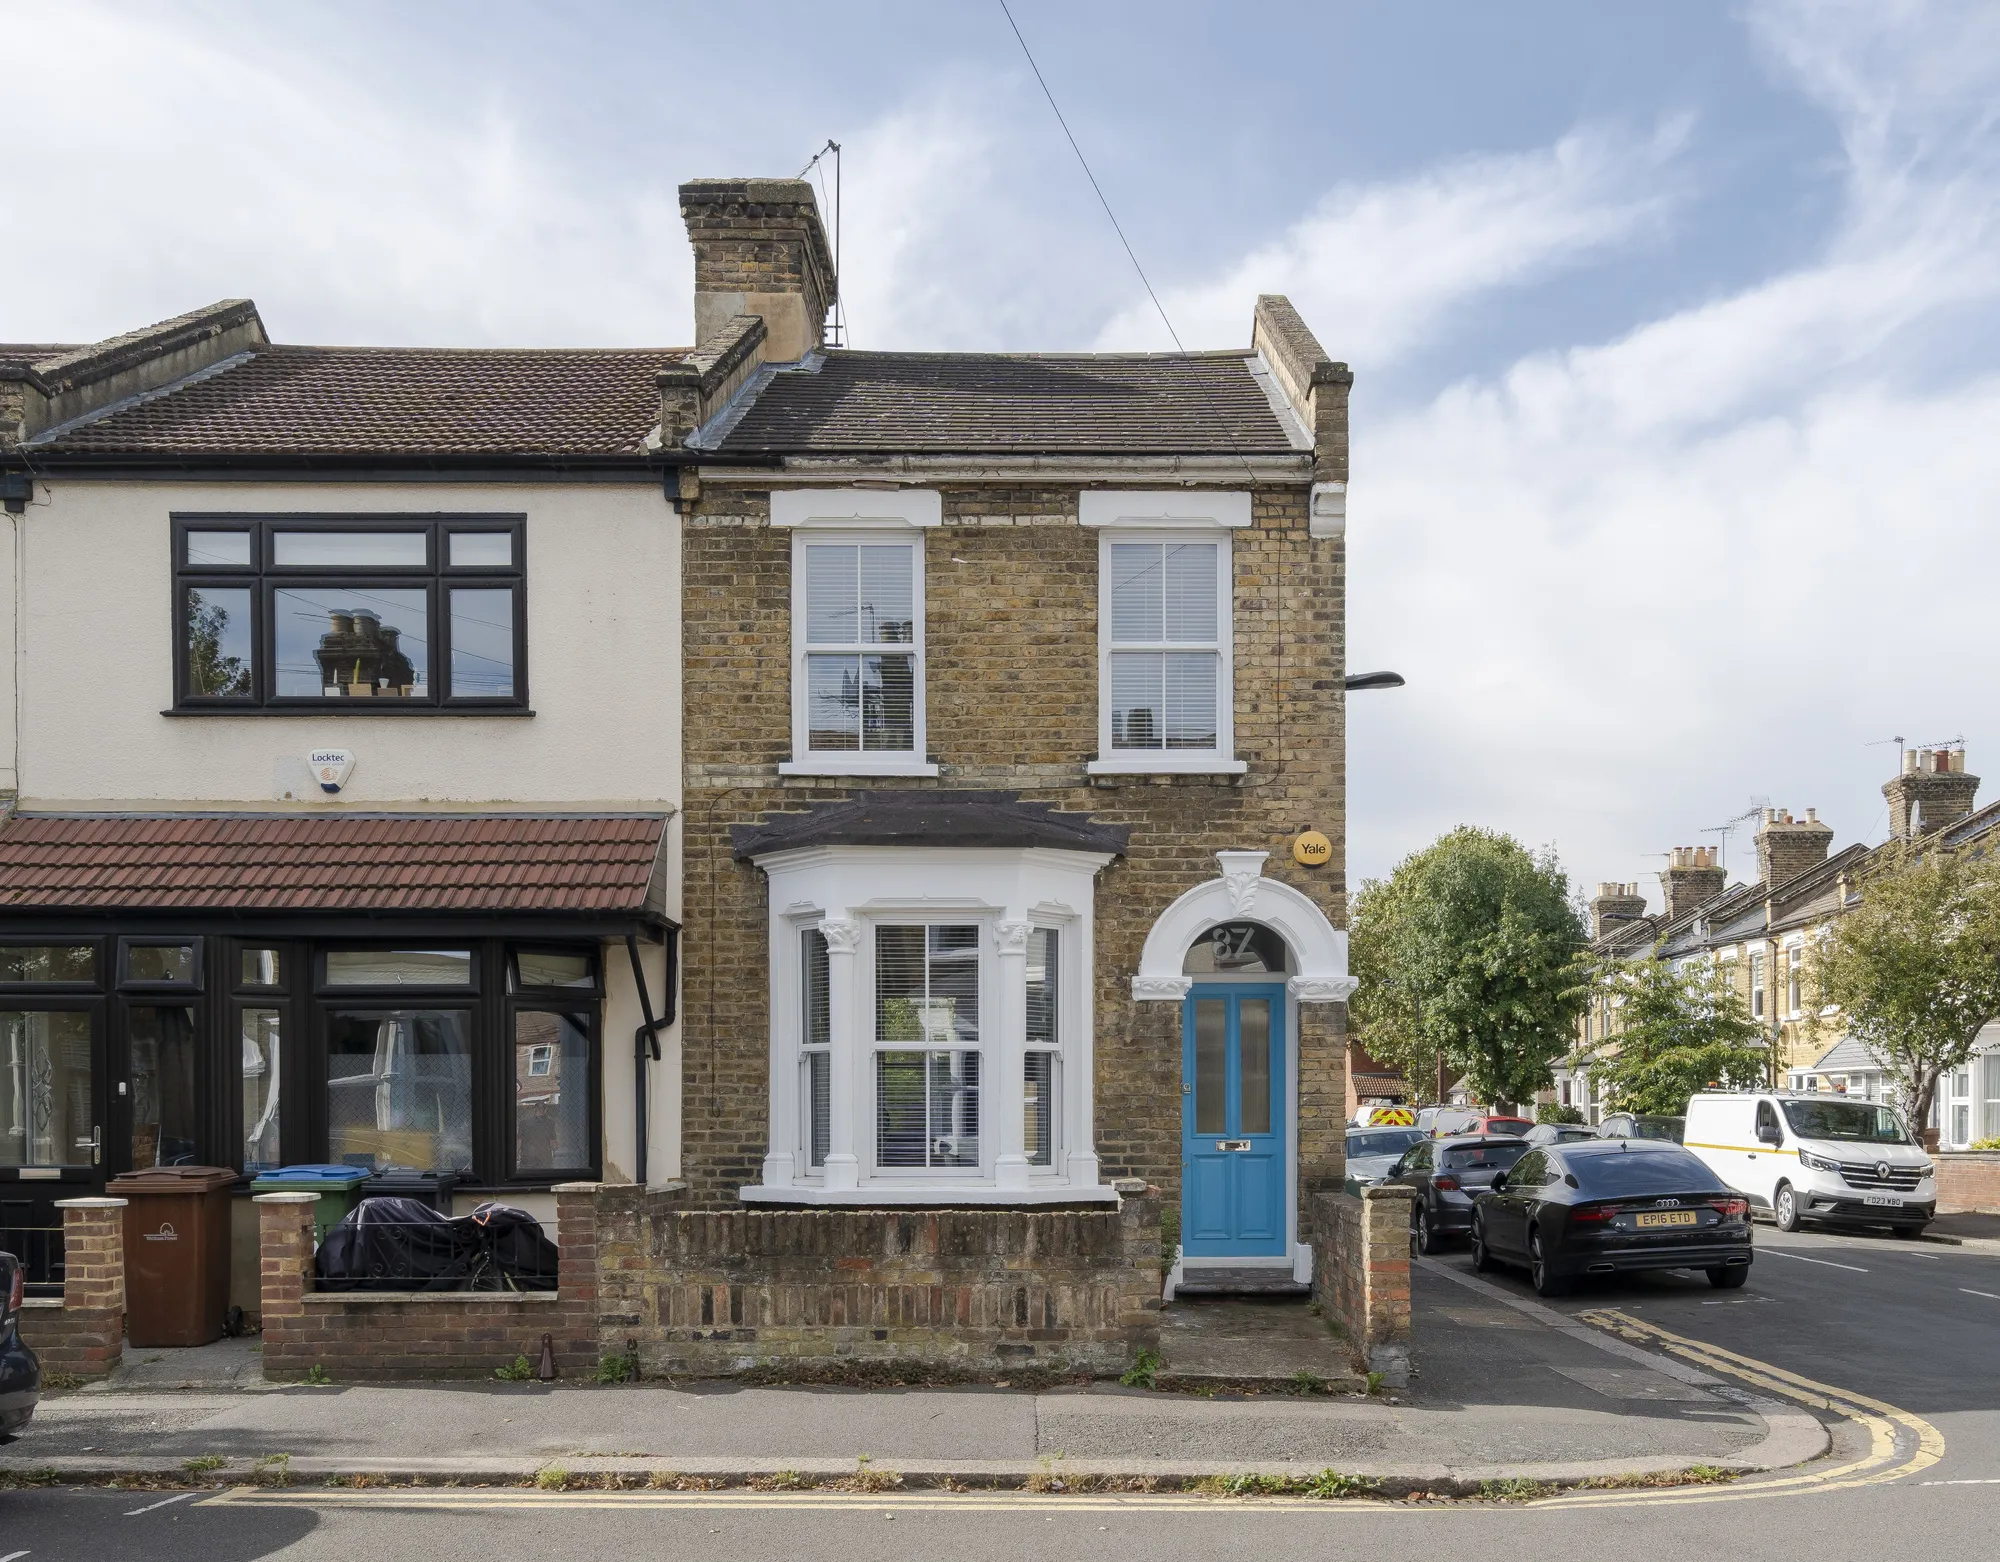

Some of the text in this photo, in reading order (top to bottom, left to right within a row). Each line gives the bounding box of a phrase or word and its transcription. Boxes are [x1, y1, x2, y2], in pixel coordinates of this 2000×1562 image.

[1301, 843, 1326, 854] Yale
[1212, 927, 1255, 960] 87
[1643, 1213, 1691, 1224] EP16 ETD
